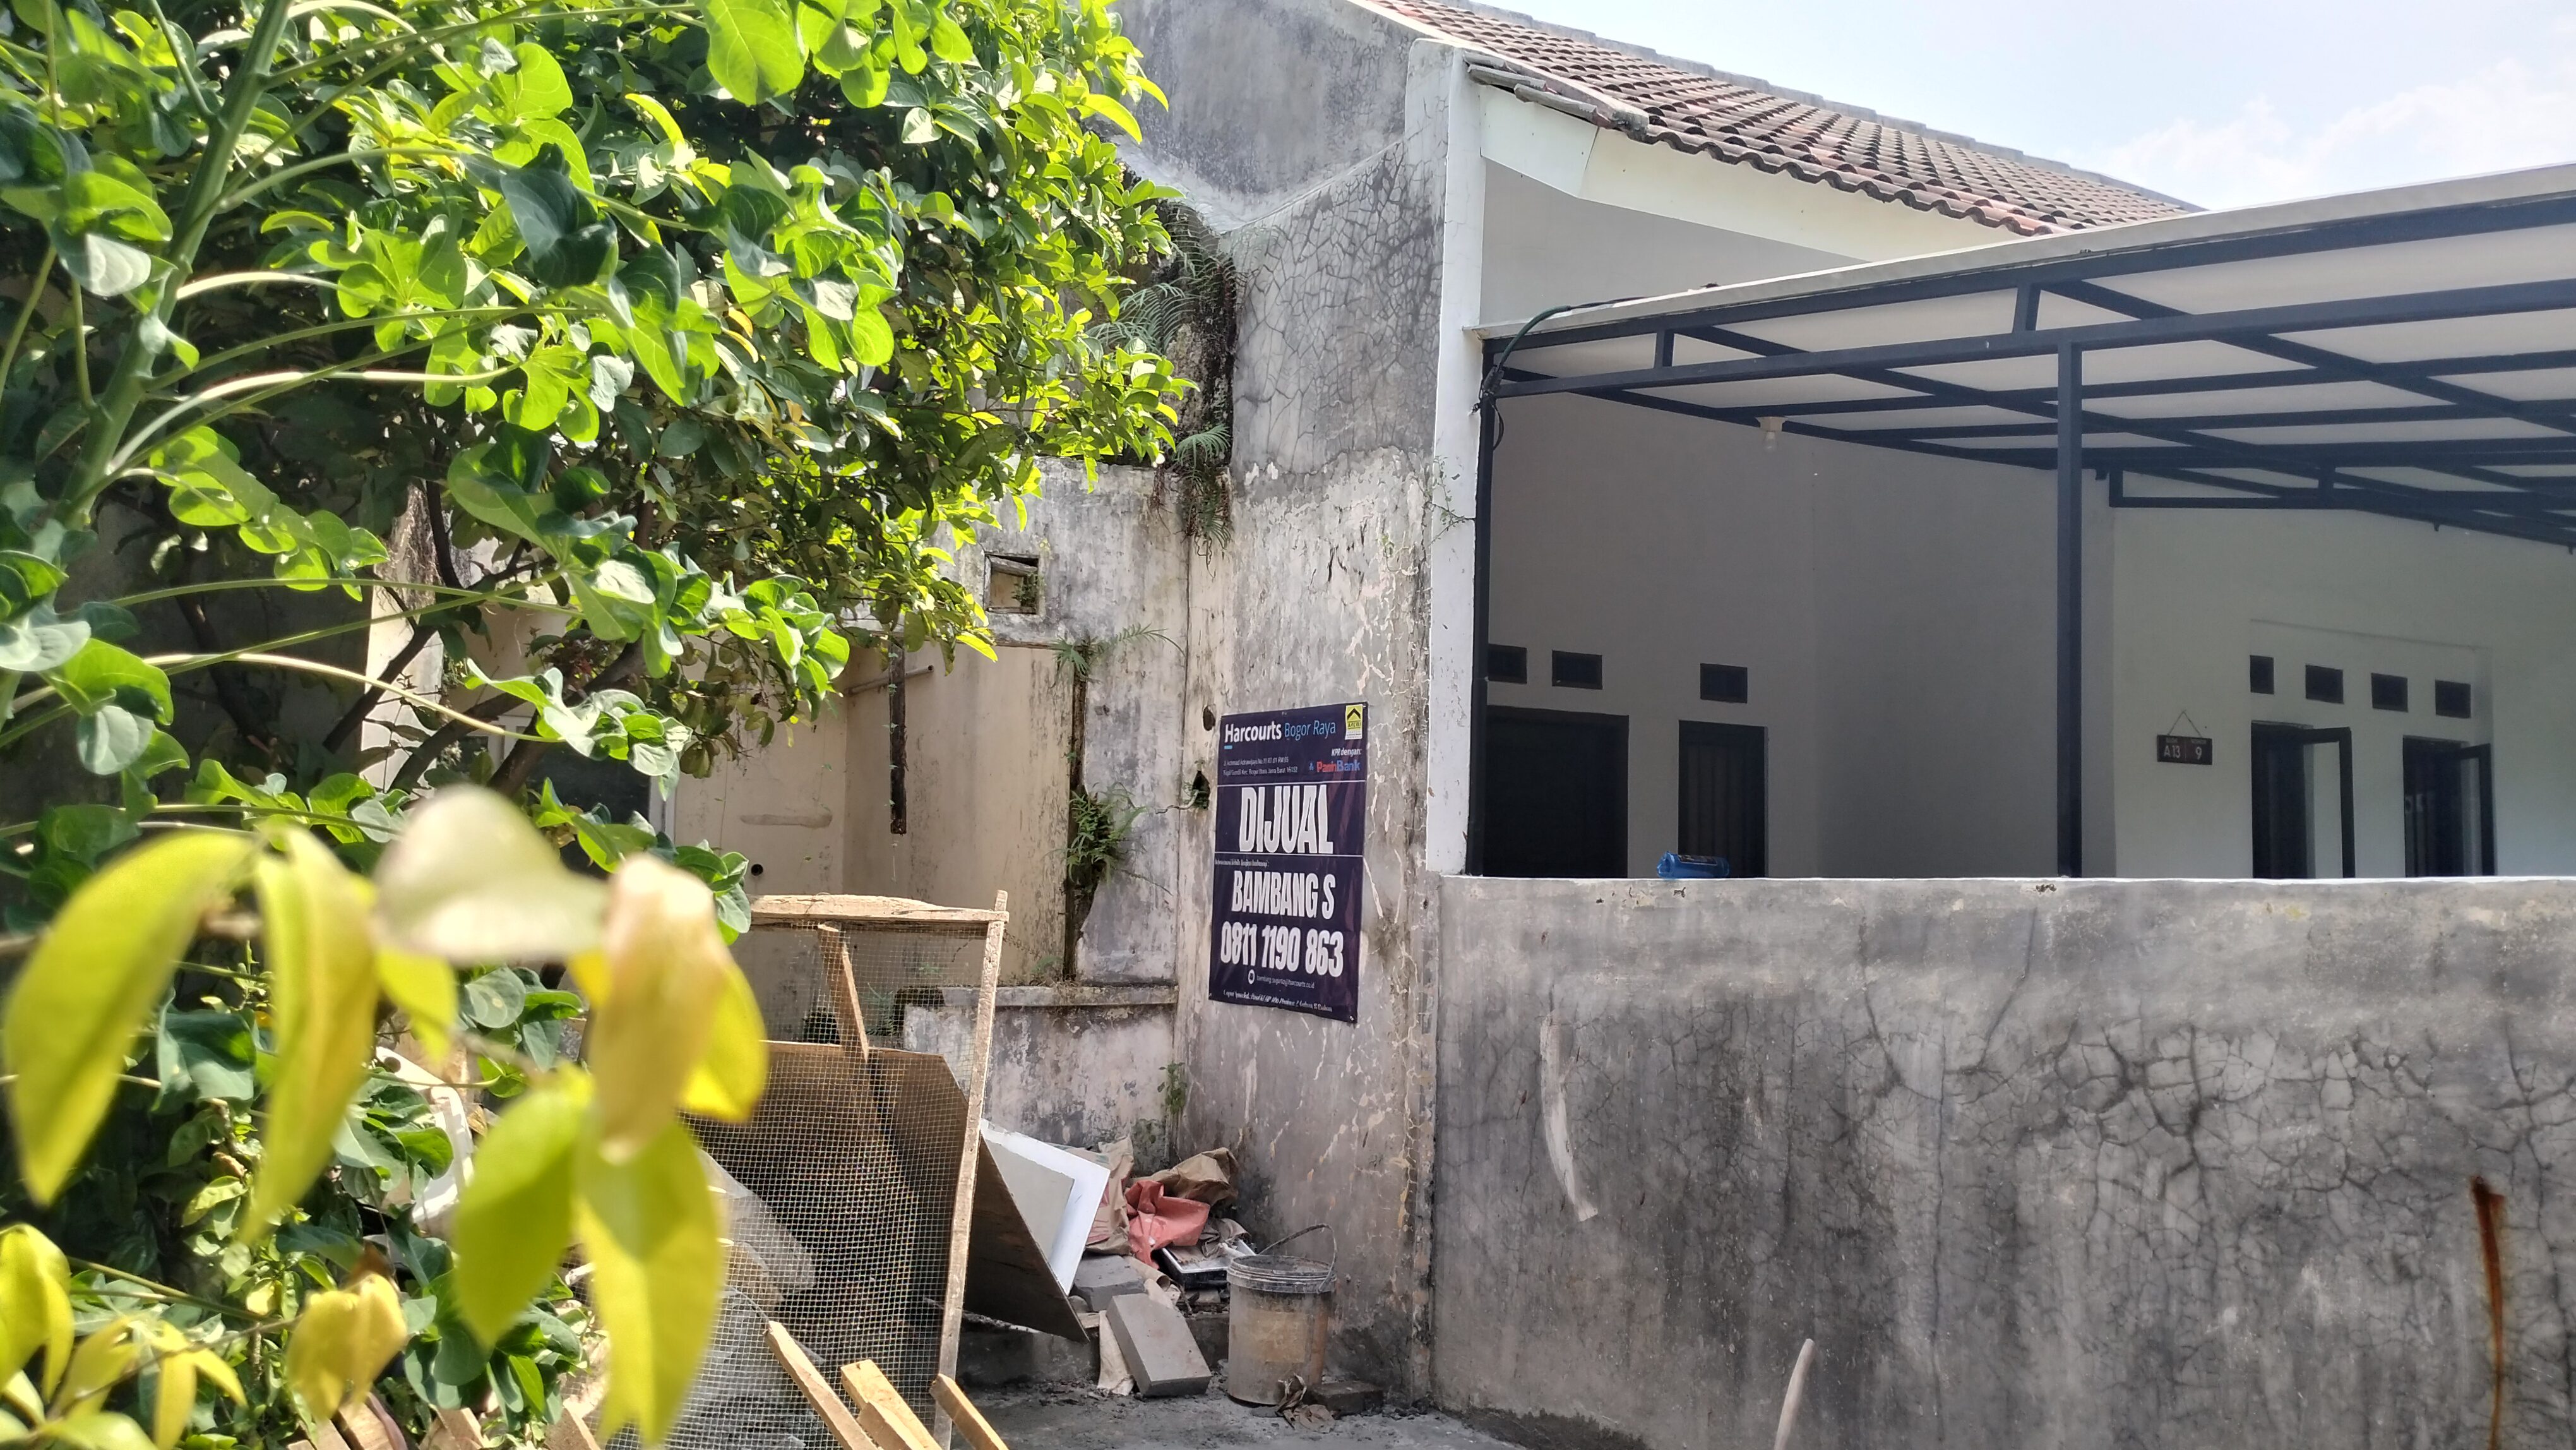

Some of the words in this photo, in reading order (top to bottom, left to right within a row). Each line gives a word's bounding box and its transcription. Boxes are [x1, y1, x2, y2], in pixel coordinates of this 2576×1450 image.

[1224, 721, 1282, 743] Harcourts
[1284, 722, 1311, 741] Bogor
[1313, 720, 1336, 739] Raya
[1331, 748, 1340, 757] KPR
[2195, 746, 2202, 760] 9
[1316, 758, 1360, 772] PaninBank
[1239, 784, 1333, 854] DIJUAL
[1231, 870, 1318, 918] BAMBANG
[1321, 874, 1336, 920] S
[1220, 921, 1257, 966] 0811
[1261, 925, 1301, 972] 1190
[1306, 928, 1344, 977] 863
